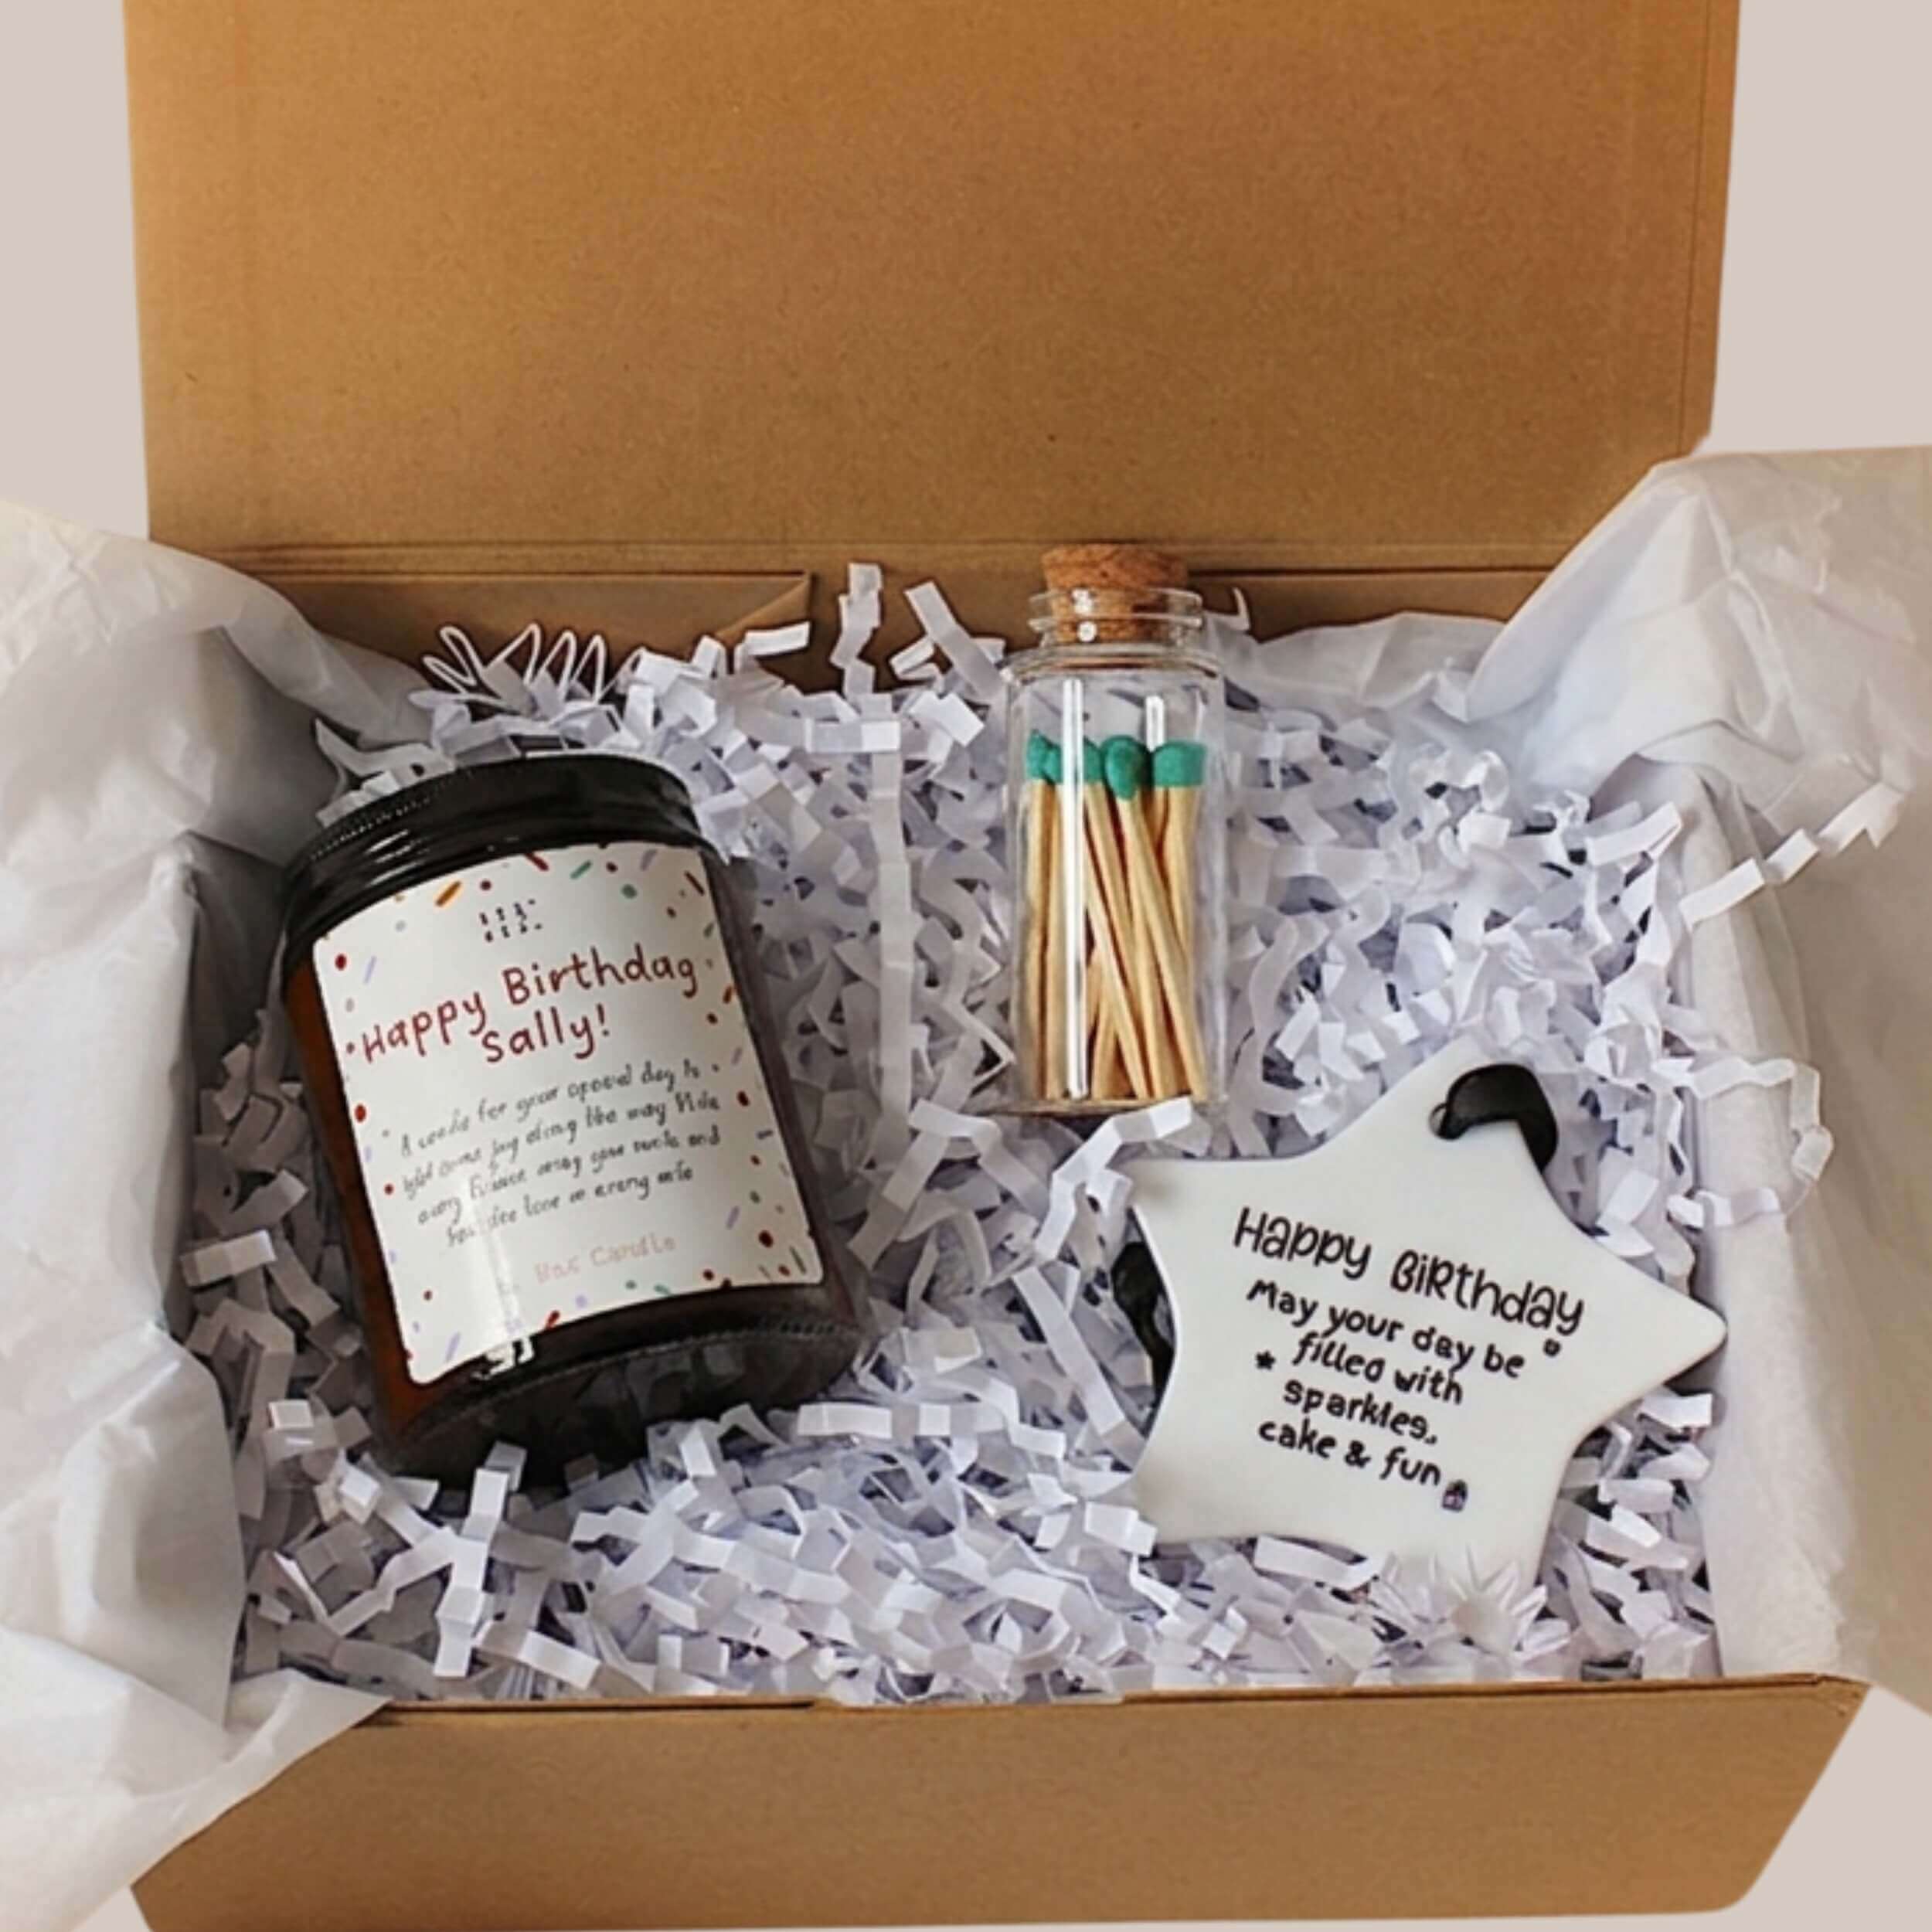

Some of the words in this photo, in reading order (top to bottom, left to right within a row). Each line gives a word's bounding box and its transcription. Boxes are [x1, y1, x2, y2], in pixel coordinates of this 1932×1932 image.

[362, 992, 487, 1063] Happy
[1233, 1206, 1372, 1281] Happy
[1247, 1279, 1319, 1328] May
[1322, 1305, 1405, 1342] your
[1413, 1326, 1475, 1375] day
[1484, 1343, 1526, 1379] be
[1393, 1365, 1464, 1406] with
[1257, 1418, 1338, 1459] cake
[1345, 1440, 1372, 1469] &
